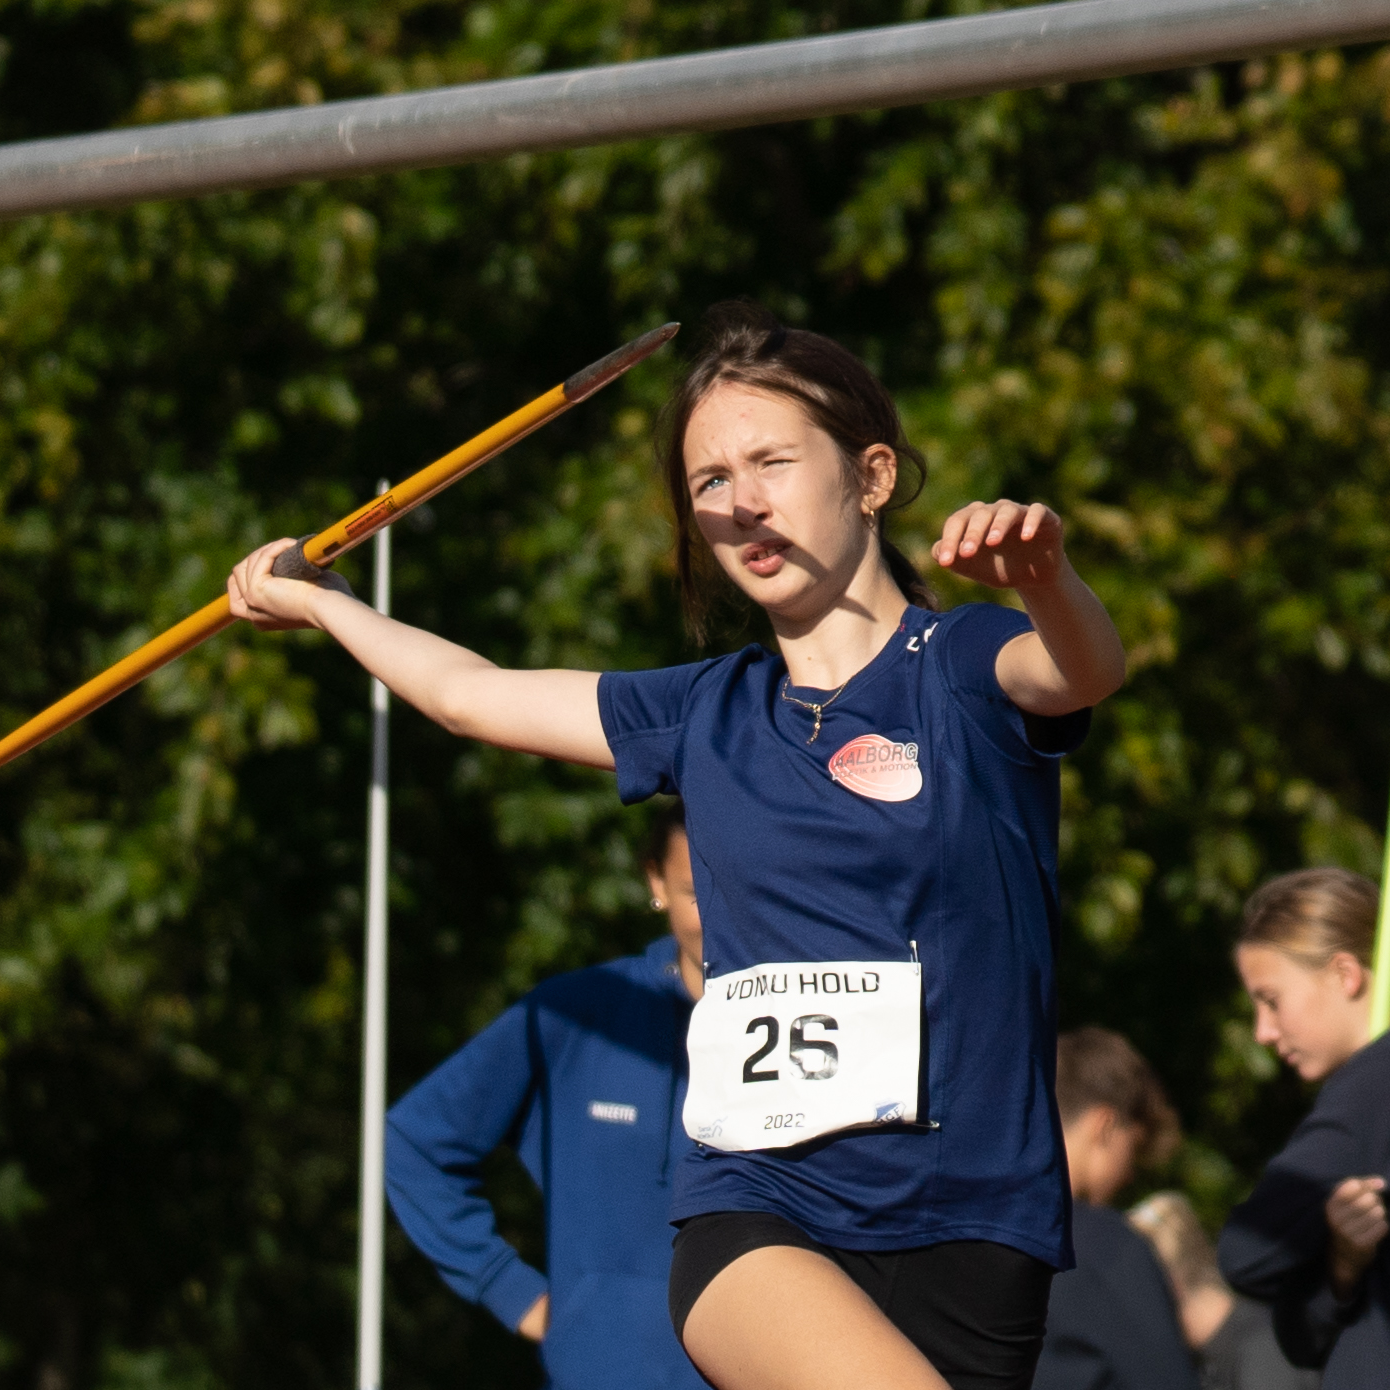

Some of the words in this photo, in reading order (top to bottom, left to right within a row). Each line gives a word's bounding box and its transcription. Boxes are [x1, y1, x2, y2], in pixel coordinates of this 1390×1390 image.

[835, 744, 917, 768] AALBORG
[879, 762, 917, 773] MOTION
[799, 972, 881, 995] HOLD
[742, 1014, 840, 1084] 26
[764, 1112, 806, 1130] 2022
